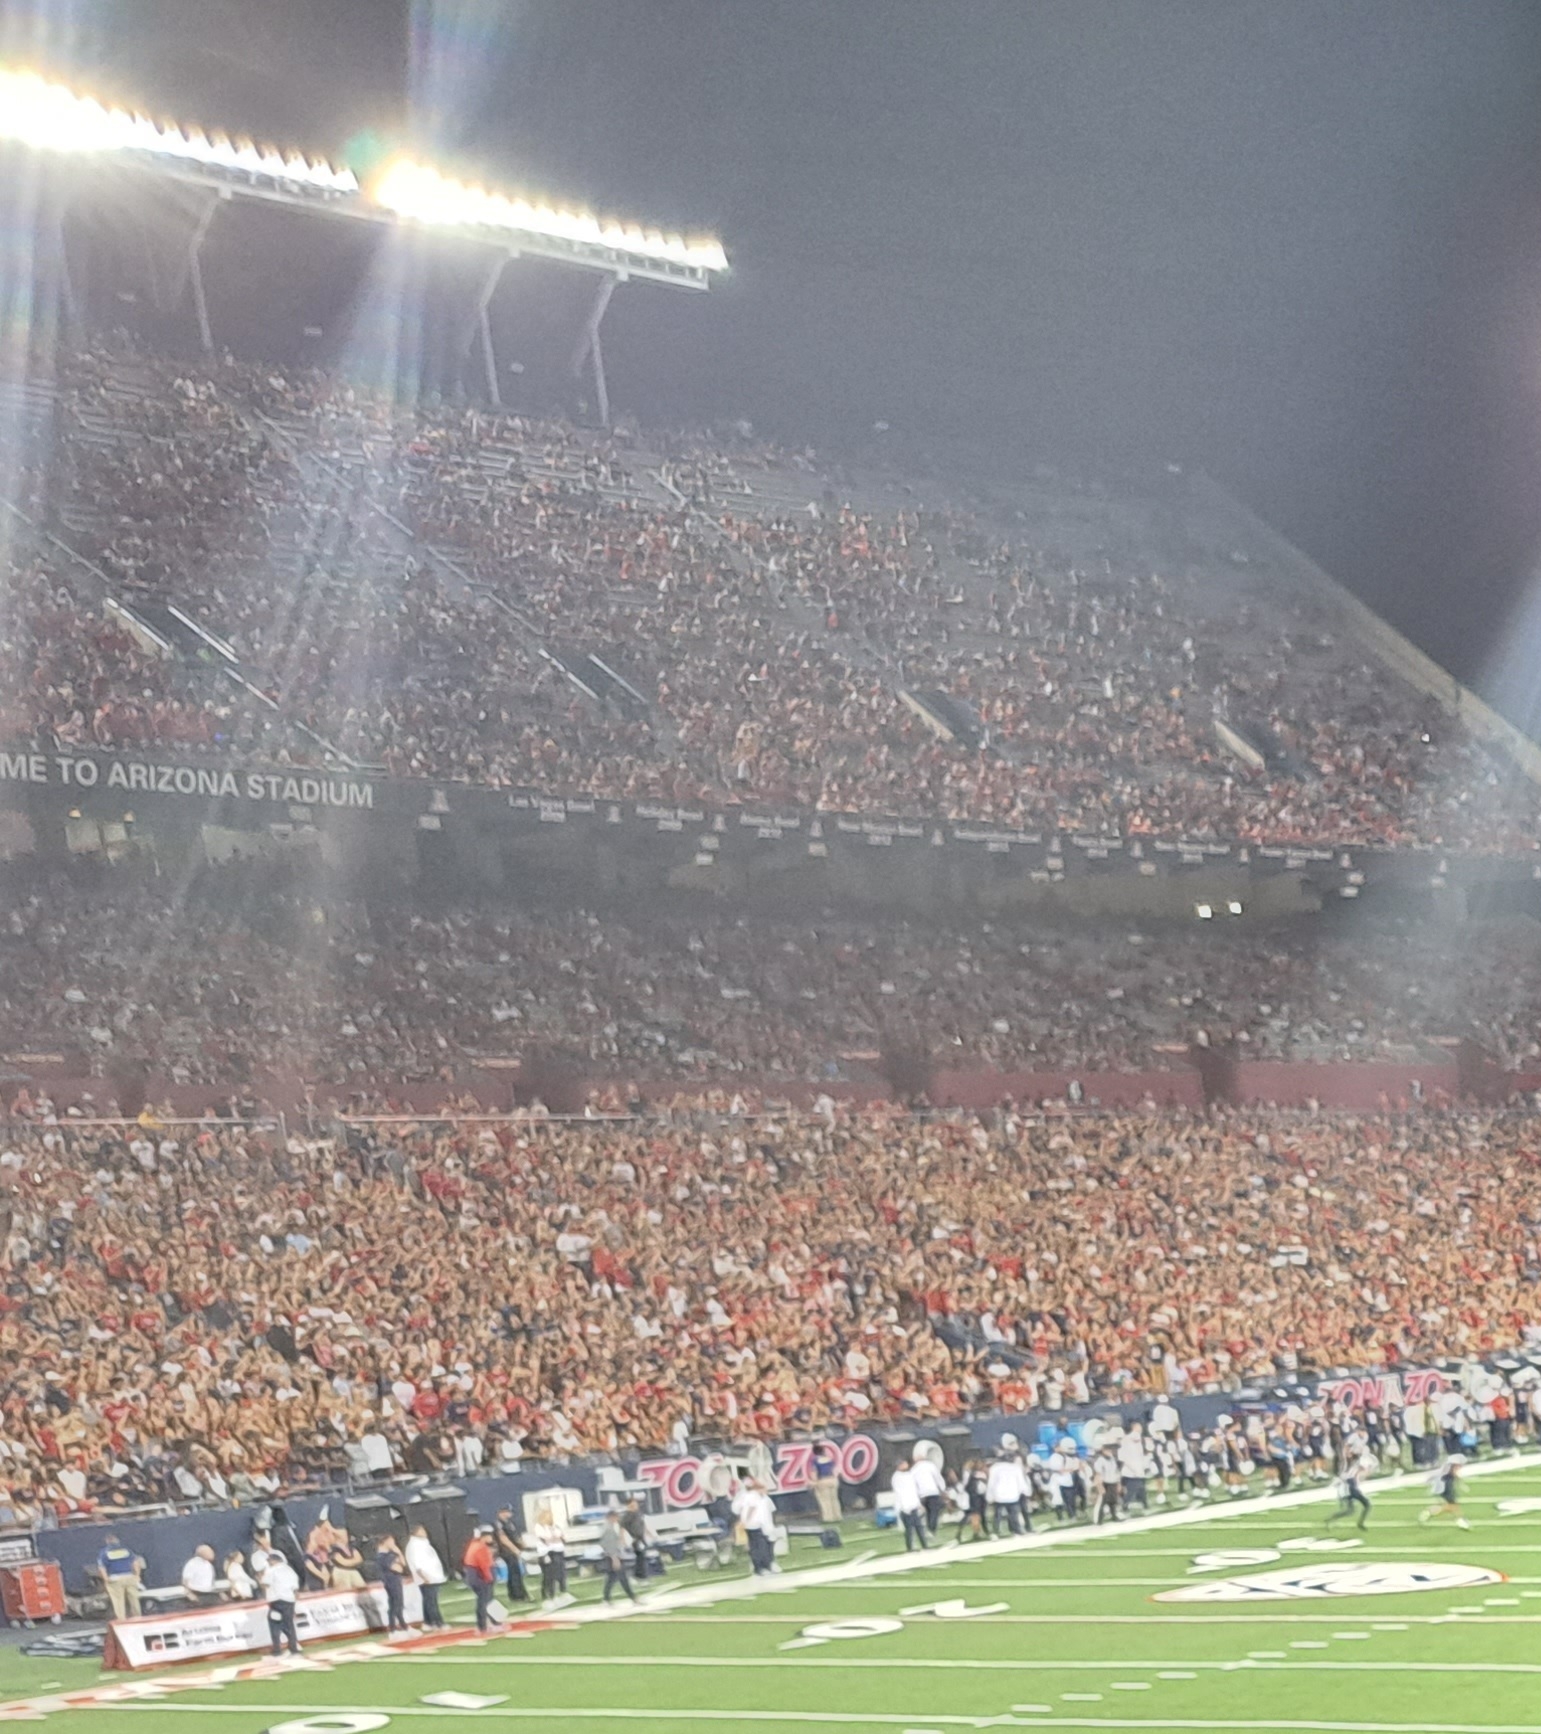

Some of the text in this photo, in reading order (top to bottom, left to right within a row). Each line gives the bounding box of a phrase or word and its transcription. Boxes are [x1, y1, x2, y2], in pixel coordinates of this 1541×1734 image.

[56, 756, 99, 787] TO
[107, 762, 240, 799] ARIZONA
[247, 774, 374, 809] STADIUM
